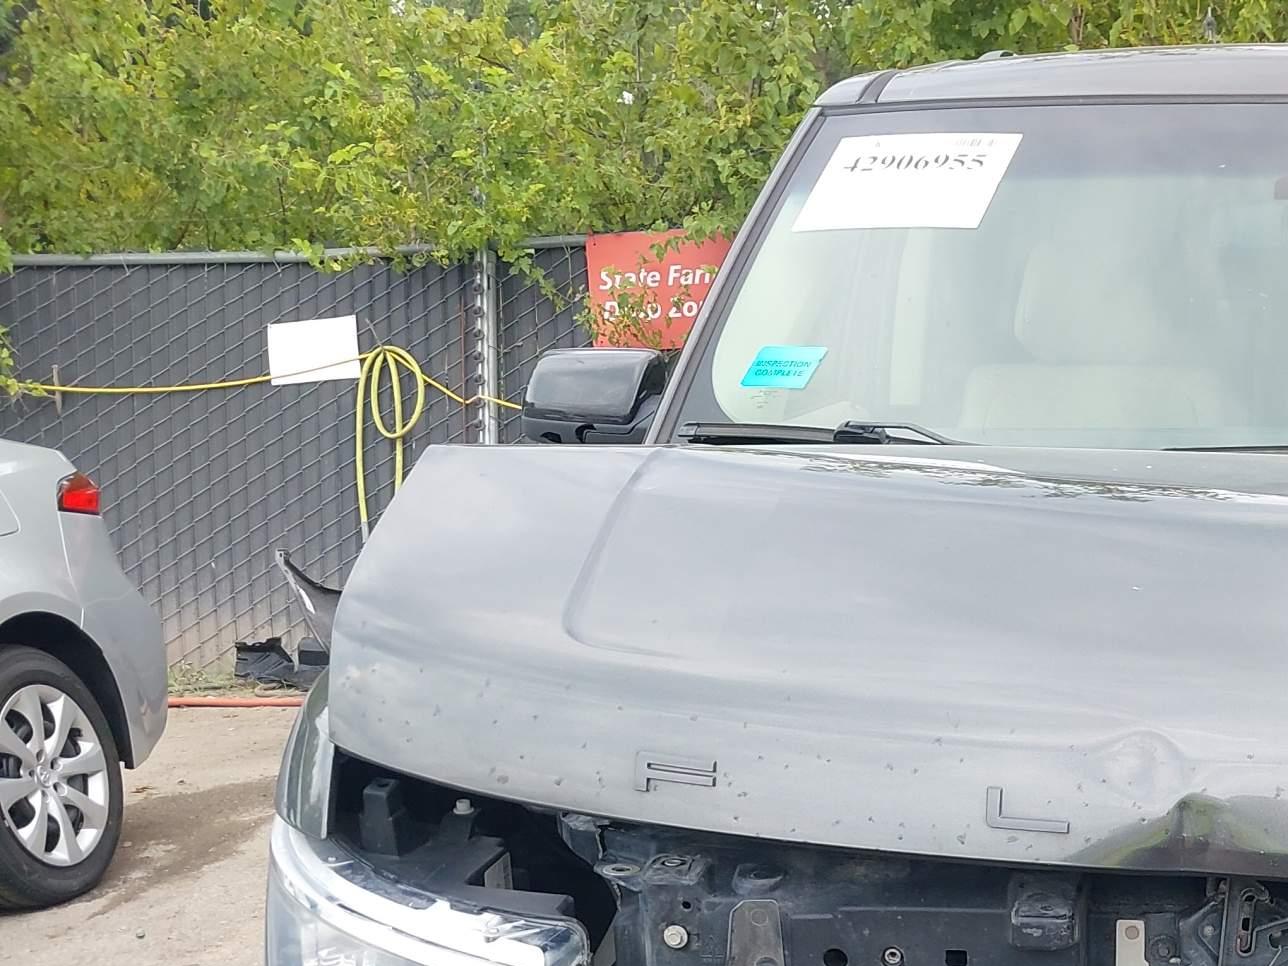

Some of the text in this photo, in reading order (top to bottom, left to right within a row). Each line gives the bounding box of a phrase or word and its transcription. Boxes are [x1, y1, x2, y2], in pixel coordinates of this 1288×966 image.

[842, 153, 988, 173] 42906955
[603, 297, 703, 321] Dp Zo
[754, 368, 805, 377] COMPLETE
